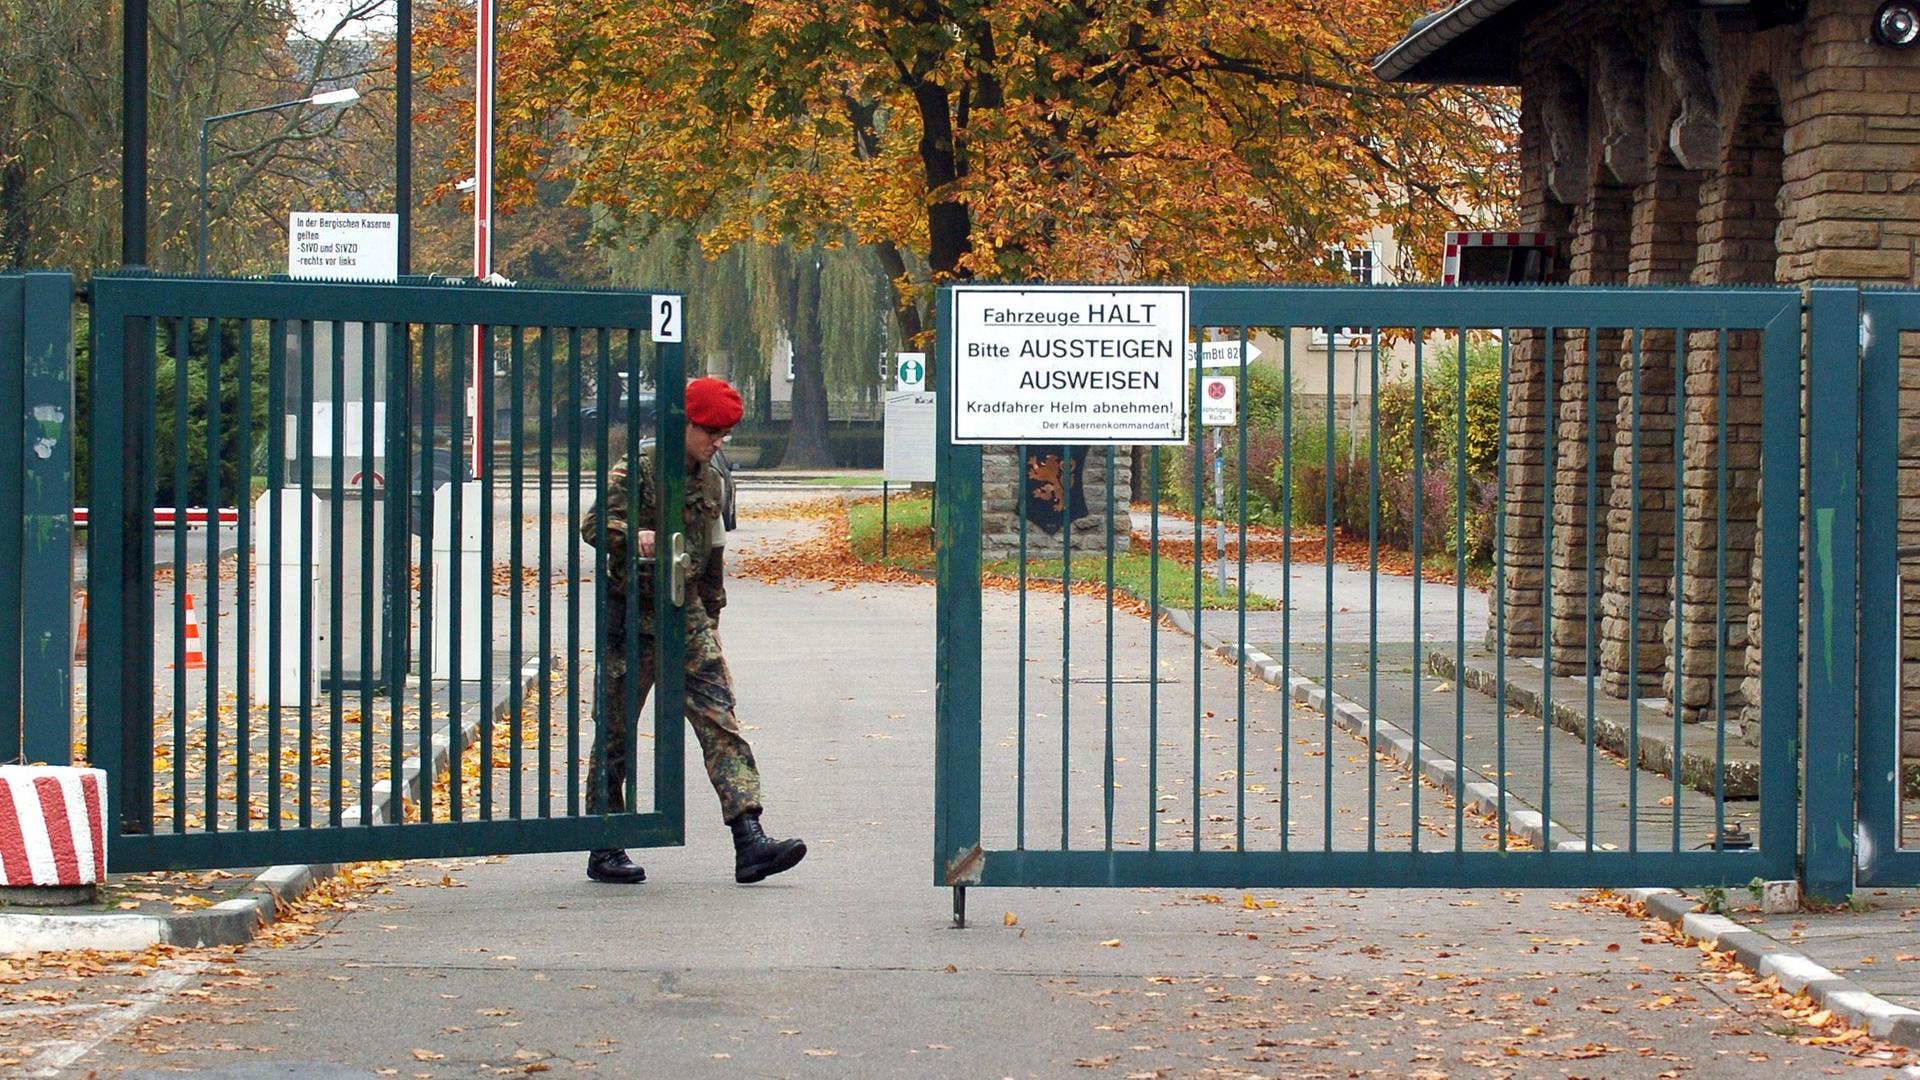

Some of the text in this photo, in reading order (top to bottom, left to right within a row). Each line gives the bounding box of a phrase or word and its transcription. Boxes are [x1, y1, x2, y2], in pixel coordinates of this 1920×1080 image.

[297, 218, 391, 229] In der Bergischen Kaserne
[297, 231, 319, 241] gelten
[320, 243, 333, 253] und
[335, 243, 358, 253] StVZO
[325, 258, 336, 266] vor
[338, 256, 356, 266] links
[660, 300, 672, 337] 2
[984, 304, 1156, 326] Fahrzeuge HALT
[968, 339, 1173, 358] Bitte AUSSTEIGEN
[1019, 371, 1159, 390] AUSWEISEN
[967, 401, 1174, 414] Kradfahrer Helm abnehmen!
[1042, 421, 1170, 430] Der Kasernenkommandant
